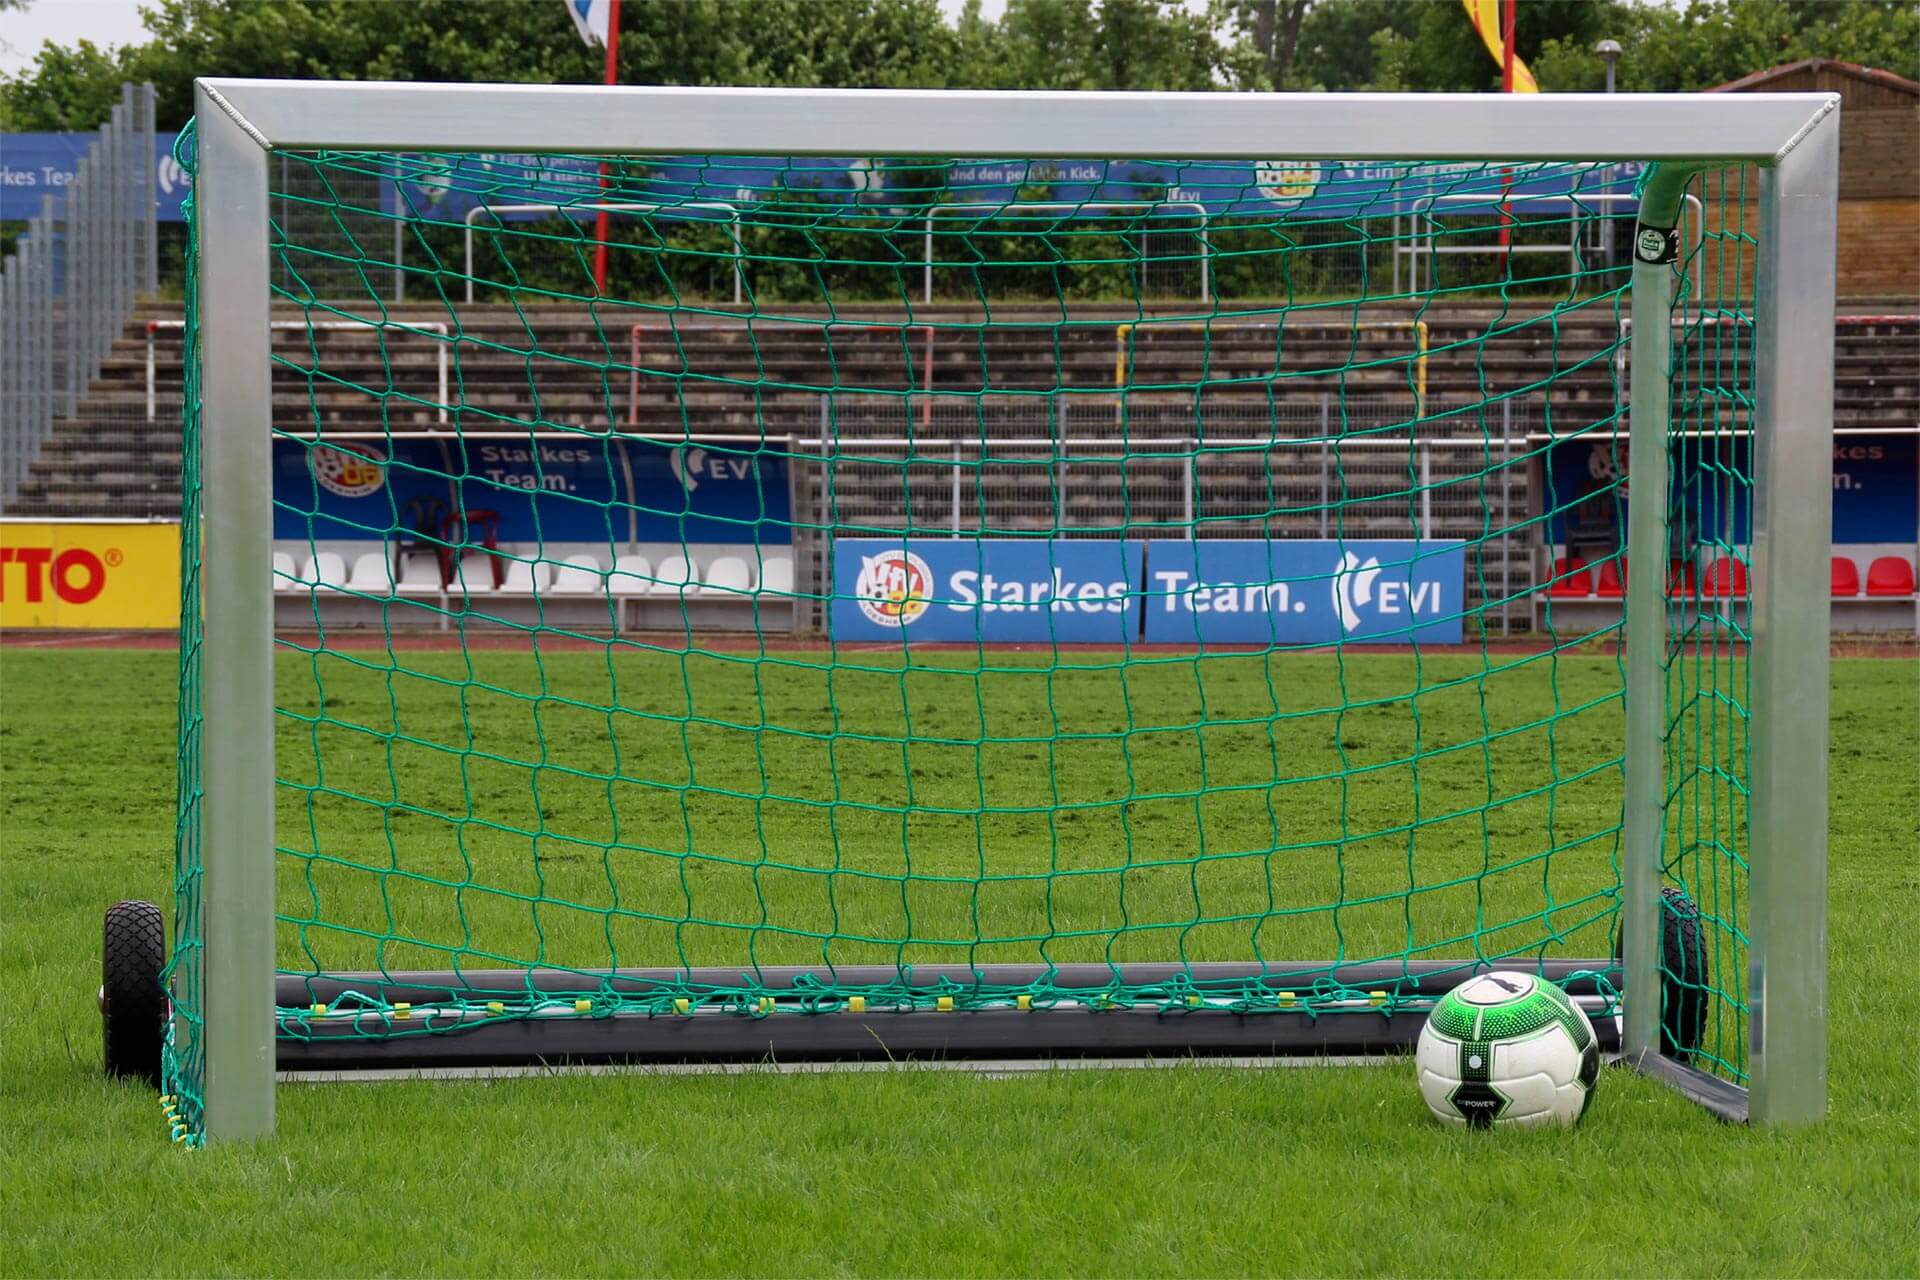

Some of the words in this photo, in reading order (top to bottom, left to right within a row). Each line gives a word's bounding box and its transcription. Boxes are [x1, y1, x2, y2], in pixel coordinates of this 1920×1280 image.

[978, 167, 1002, 180] den
[1070, 166, 1101, 179] Kick.
[485, 469, 577, 491] Team.
[947, 567, 1131, 613] Starkes
[1155, 571, 1306, 613] Team.
[1378, 581, 1441, 614] EVI
